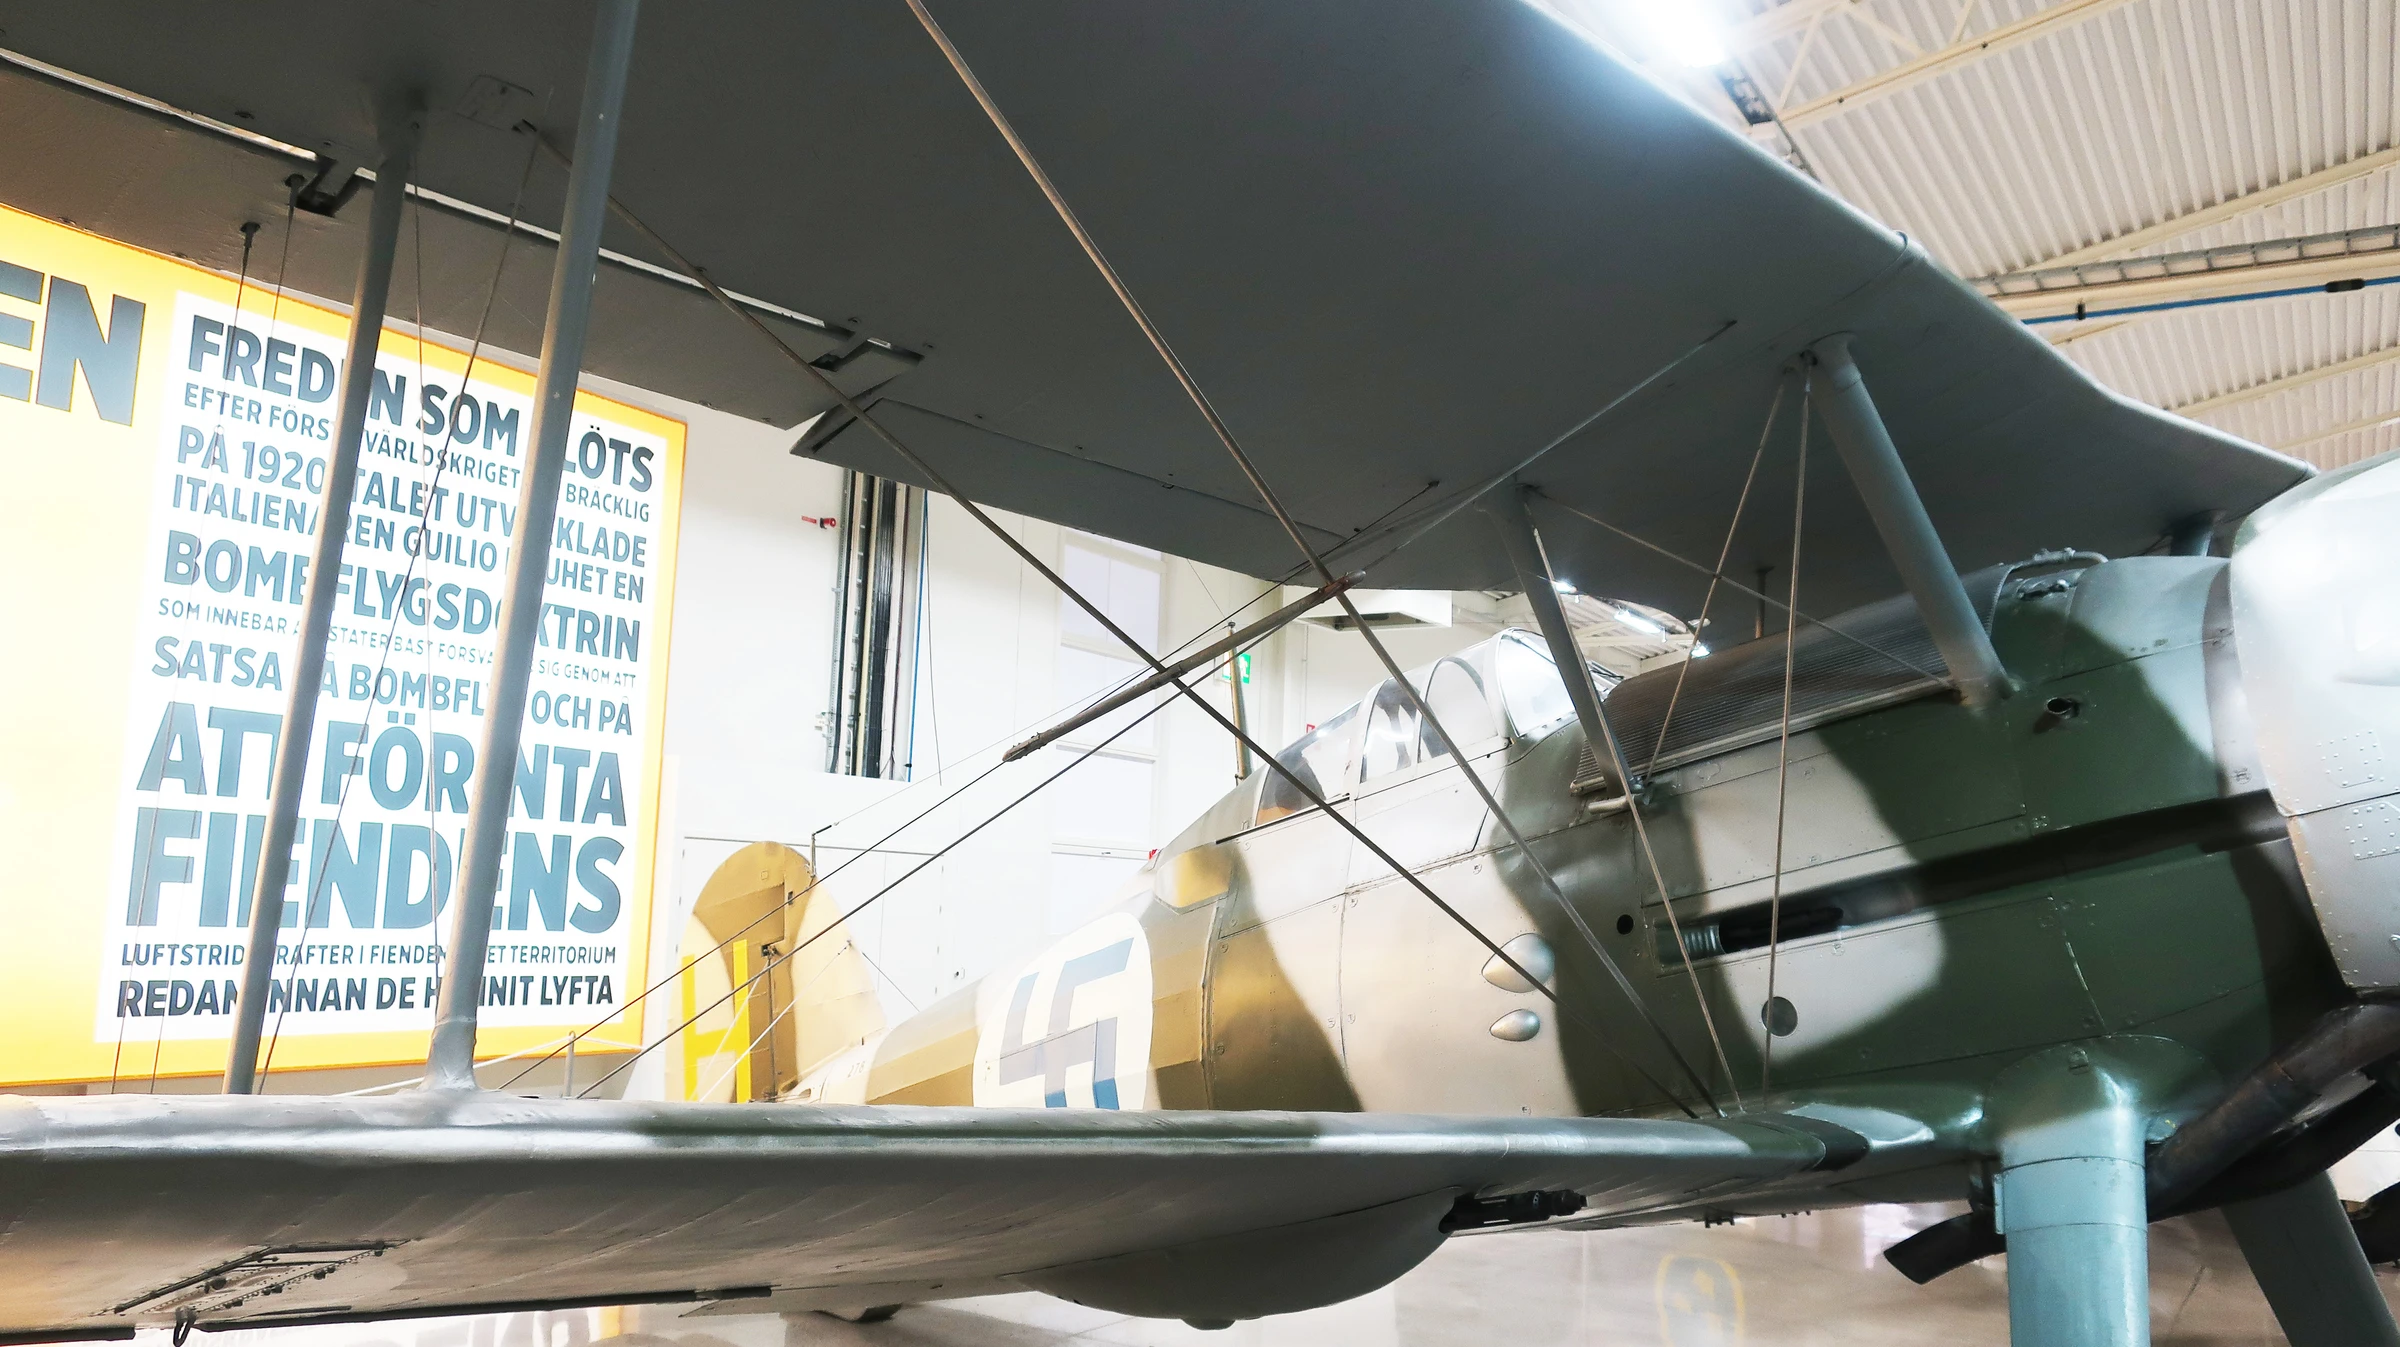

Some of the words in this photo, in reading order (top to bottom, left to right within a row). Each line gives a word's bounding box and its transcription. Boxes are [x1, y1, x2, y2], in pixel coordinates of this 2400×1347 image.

[184, 382, 262, 425] EFTER
[269, 403, 335, 442] FÖRS
[364, 429, 520, 489] VÄRLDSKRIGET
[565, 483, 650, 523] BRÄCKLIG
[188, 314, 407, 427] FREDN
[416, 384, 519, 457] SOM
[562, 424, 654, 493] ÖTS
[177, 424, 229, 474] PÅ
[242, 441, 449, 522] 1920TALET
[456, 492, 647, 568] UTVKLADE
[403, 525, 497, 572] GUILIO
[614, 571, 644, 604] EN
[151, 635, 283, 692] SATSA
[317, 651, 339, 699] Å
[348, 663, 490, 717] BOMBFL
[531, 689, 592, 731] OCH
[598, 695, 632, 736] PÅ
[158, 597, 200, 621] SOM
[206, 606, 287, 634] INNEBAR
[328, 626, 389, 648] STATER
[538, 659, 560, 677] SIG
[564, 663, 610, 685] GENOM
[613, 671, 637, 689] ATT
[320, 710, 627, 827] FÖRNTA
[268, 977, 367, 1014] NNAN
[376, 977, 416, 1010] DE
[423, 976, 534, 1009] HNIT
[540, 975, 614, 1006] LYFTA
[358, 944, 365, 965] I
[370, 944, 447, 965] FIENDEN
[510, 945, 616, 965] TERRITORIUM
